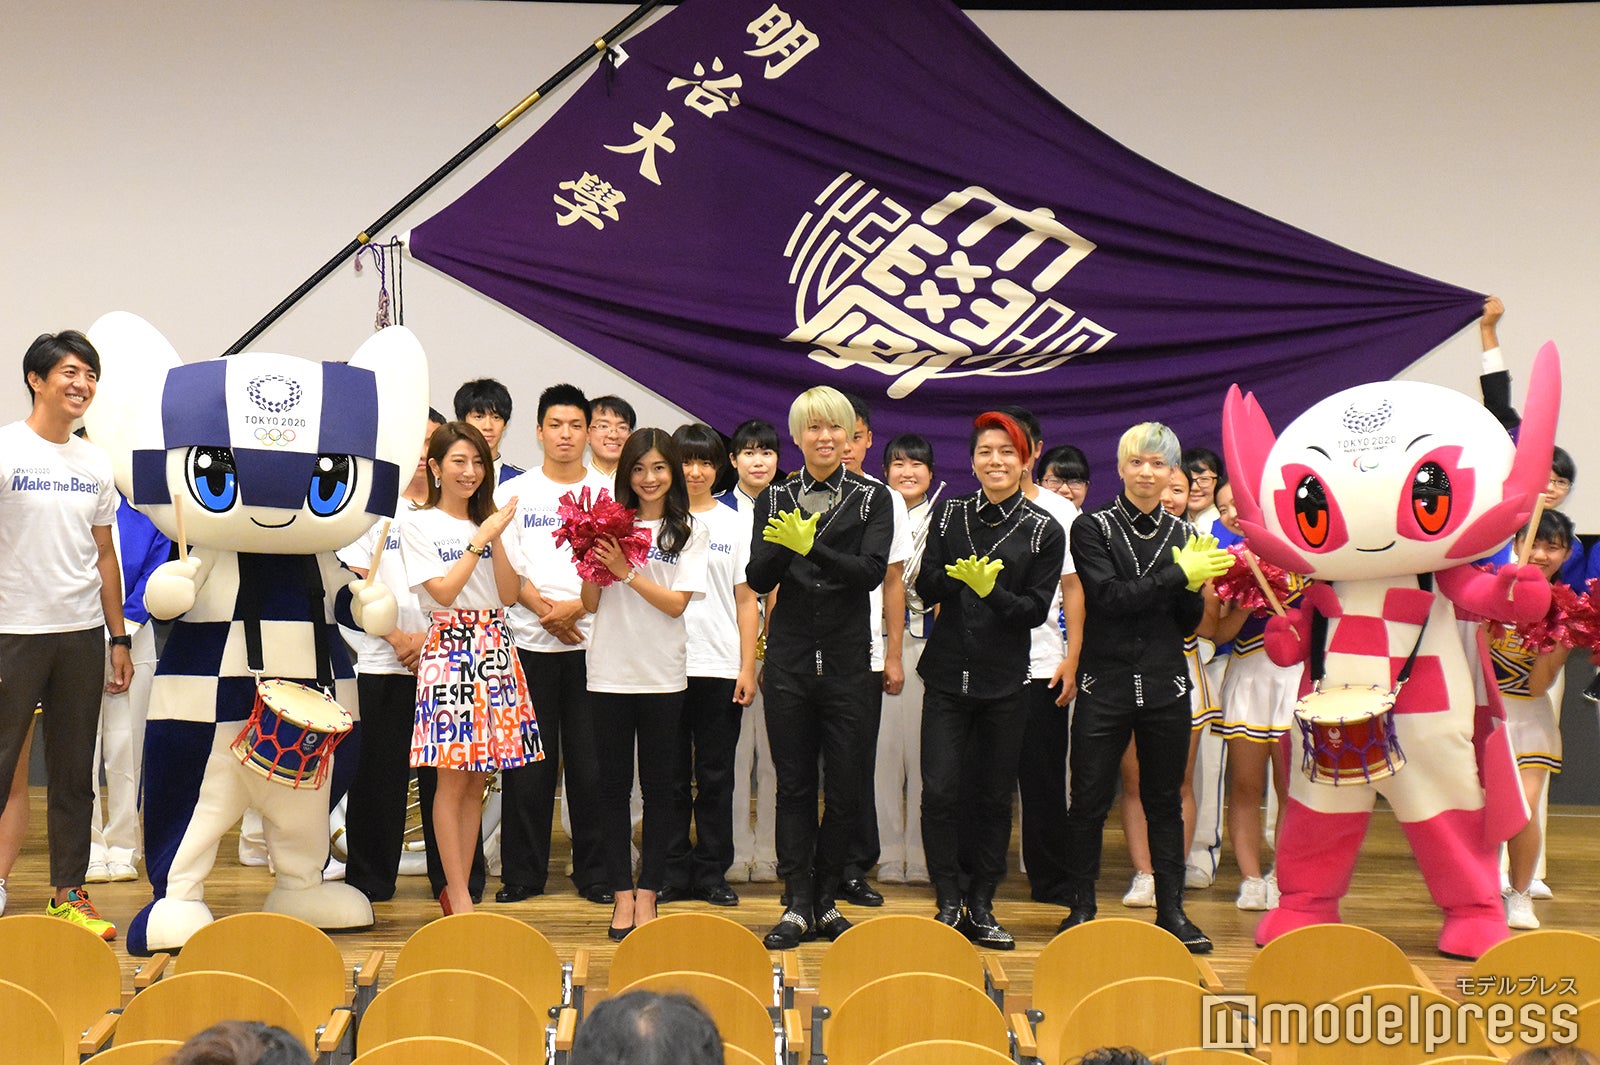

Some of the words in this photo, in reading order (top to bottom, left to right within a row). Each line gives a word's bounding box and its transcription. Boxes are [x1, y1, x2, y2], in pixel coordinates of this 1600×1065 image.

[245, 415, 278, 425] TOKYO
[281, 417, 306, 428] 2020
[1338, 437, 1370, 448] TOKYO
[1371, 435, 1397, 445] 2020
[11, 475, 51, 491] Make
[53, 480, 69, 491] The
[70, 476, 99, 494] Beat!
[524, 513, 556, 528] Make
[709, 539, 732, 555] eat!
